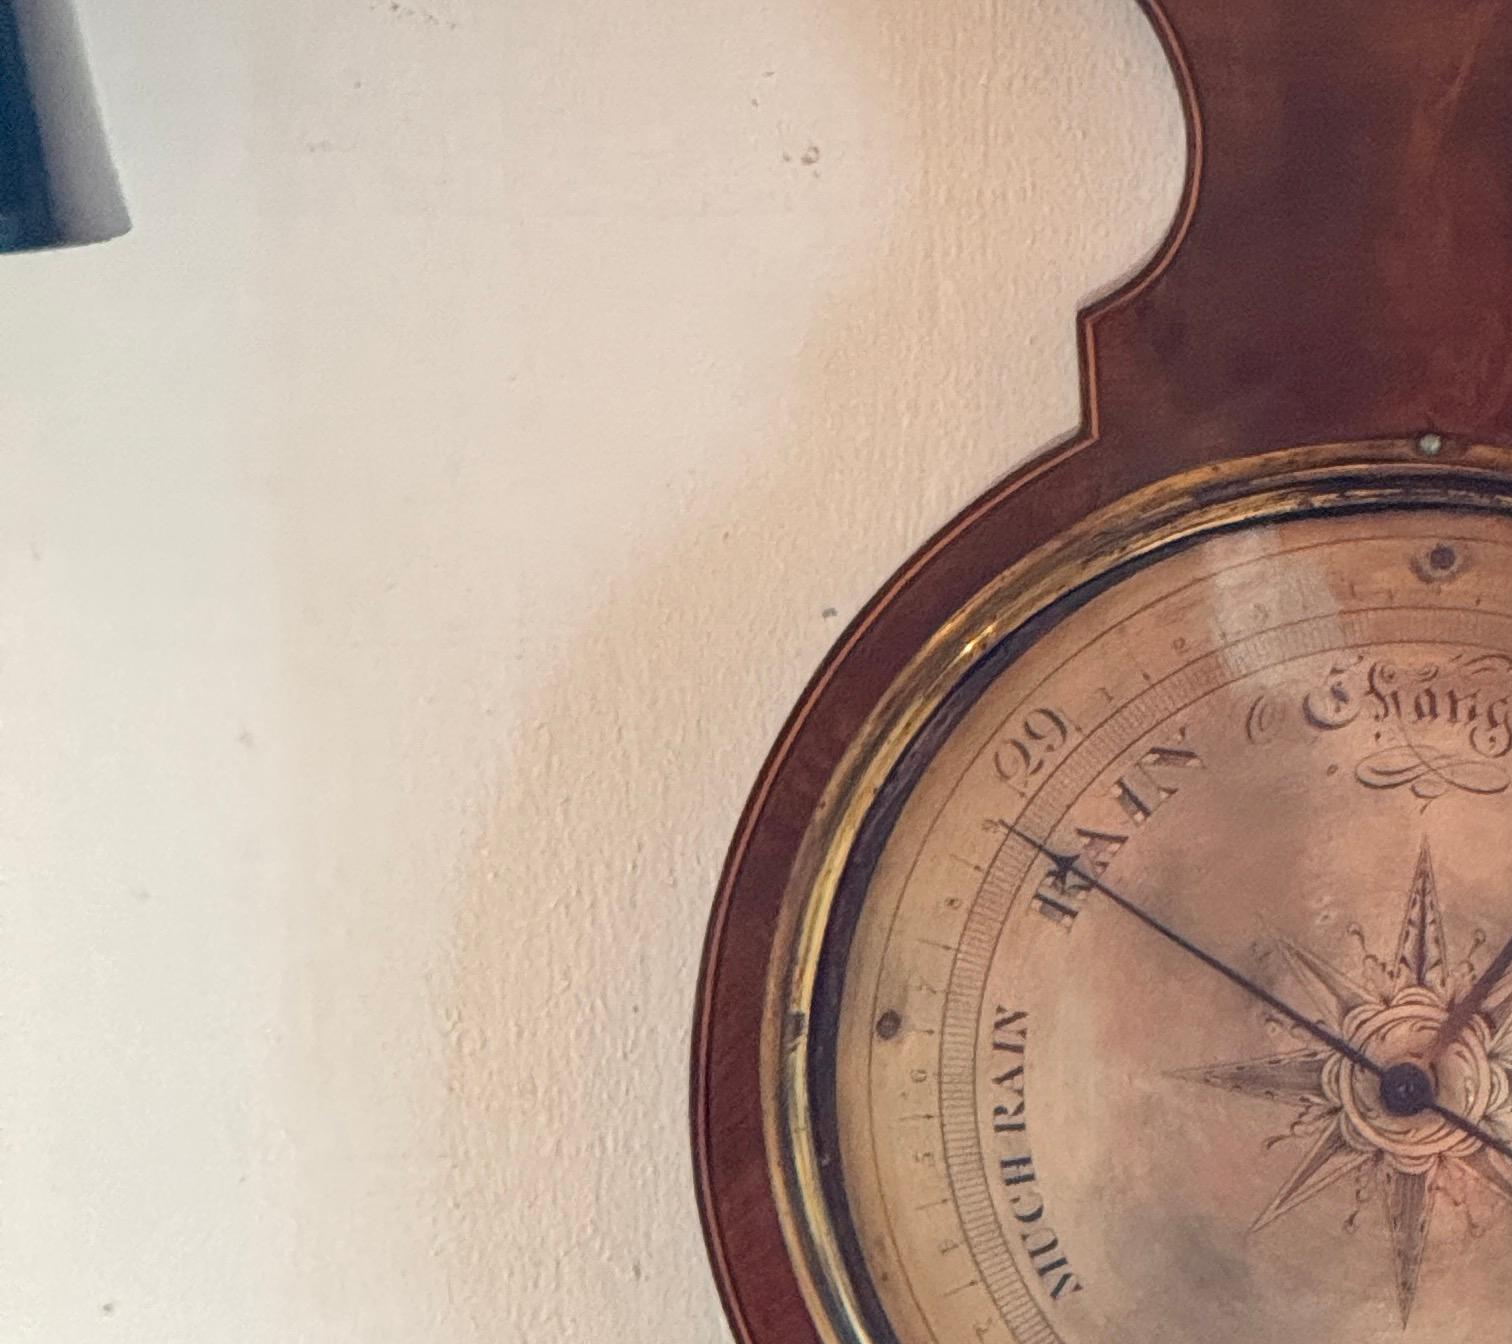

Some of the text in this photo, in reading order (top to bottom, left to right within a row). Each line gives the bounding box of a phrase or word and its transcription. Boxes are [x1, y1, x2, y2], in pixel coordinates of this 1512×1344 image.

[994, 706, 1069, 786] 29
[1029, 727, 1205, 934] RAIN
[991, 1003, 1084, 1301] MUCH RAIN
